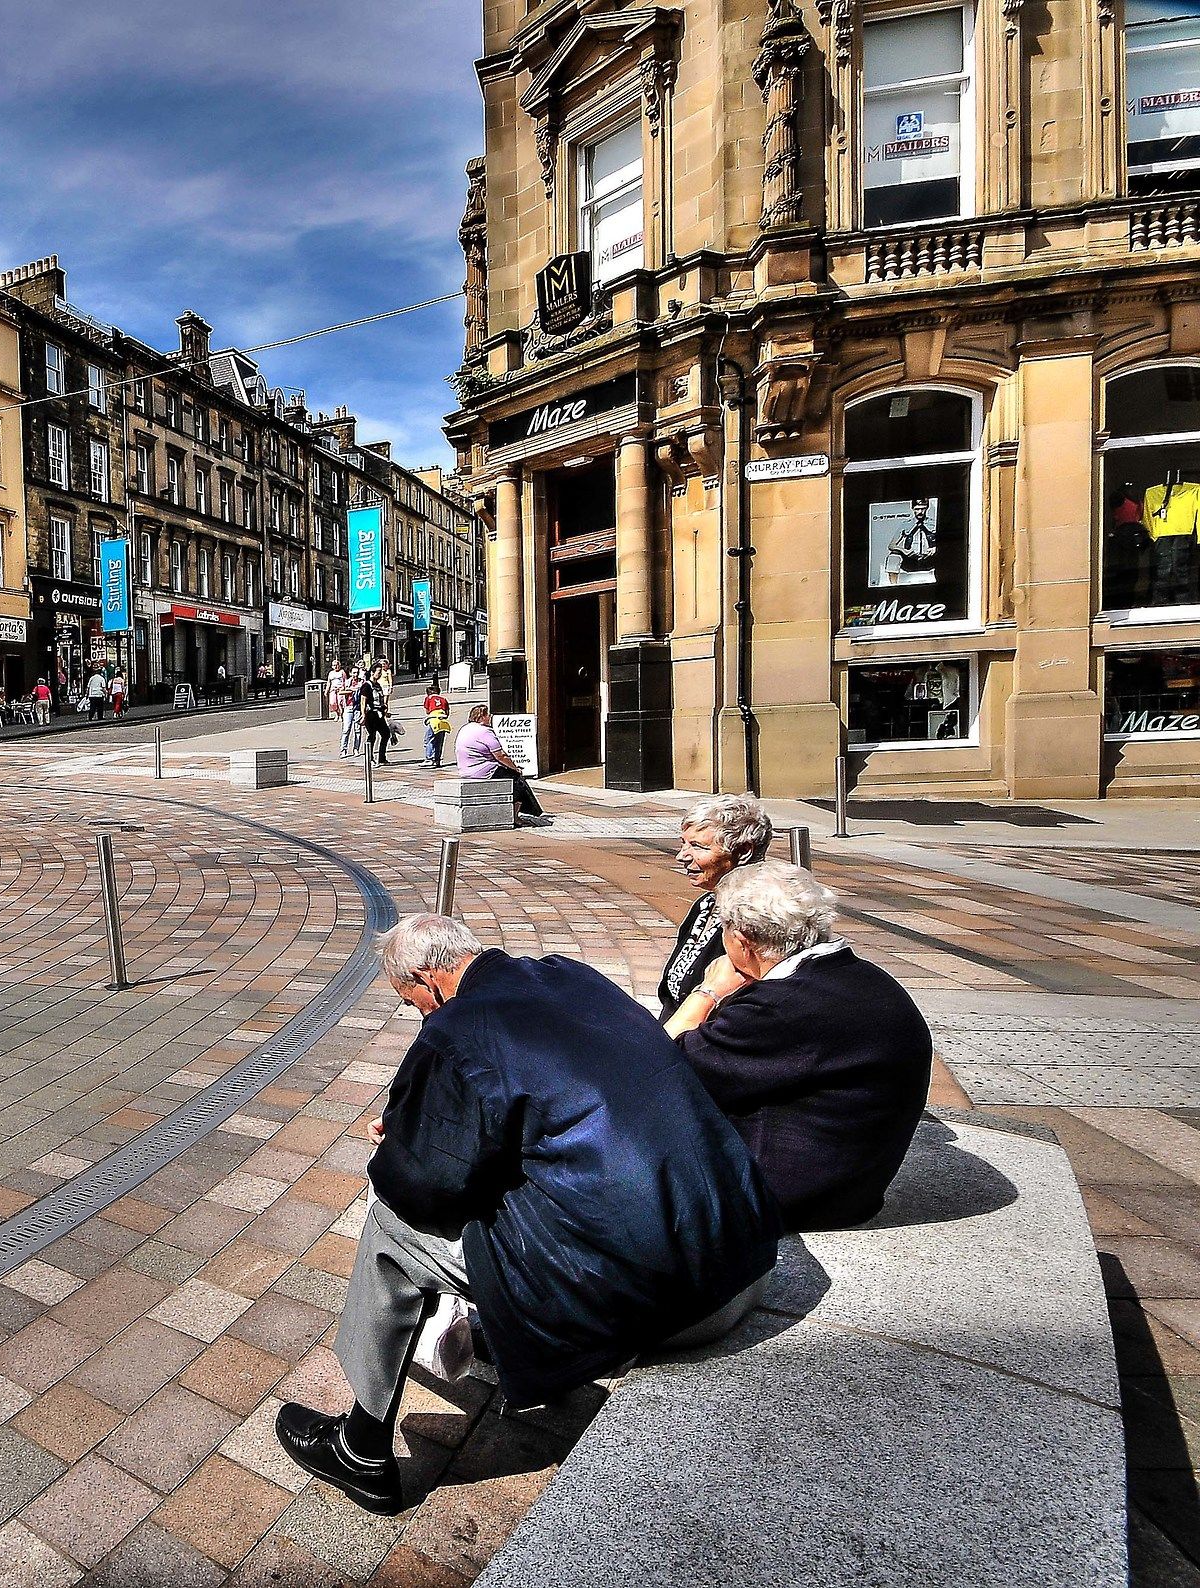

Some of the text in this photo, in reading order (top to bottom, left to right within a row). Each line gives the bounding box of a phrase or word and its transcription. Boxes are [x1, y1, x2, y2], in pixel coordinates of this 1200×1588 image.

[886, 136, 949, 153] MAILERS
[546, 291, 577, 312] MAILERS
[527, 400, 586, 435] Maze
[749, 457, 825, 472] MURRAY PLACE
[355, 530, 375, 590] Stirling
[107, 559, 122, 612] Stirling
[62, 594, 98, 607] OUTSIDE
[871, 599, 946, 621] Maze
[498, 717, 532, 728] Maze
[1120, 710, 1200, 732] Maze
